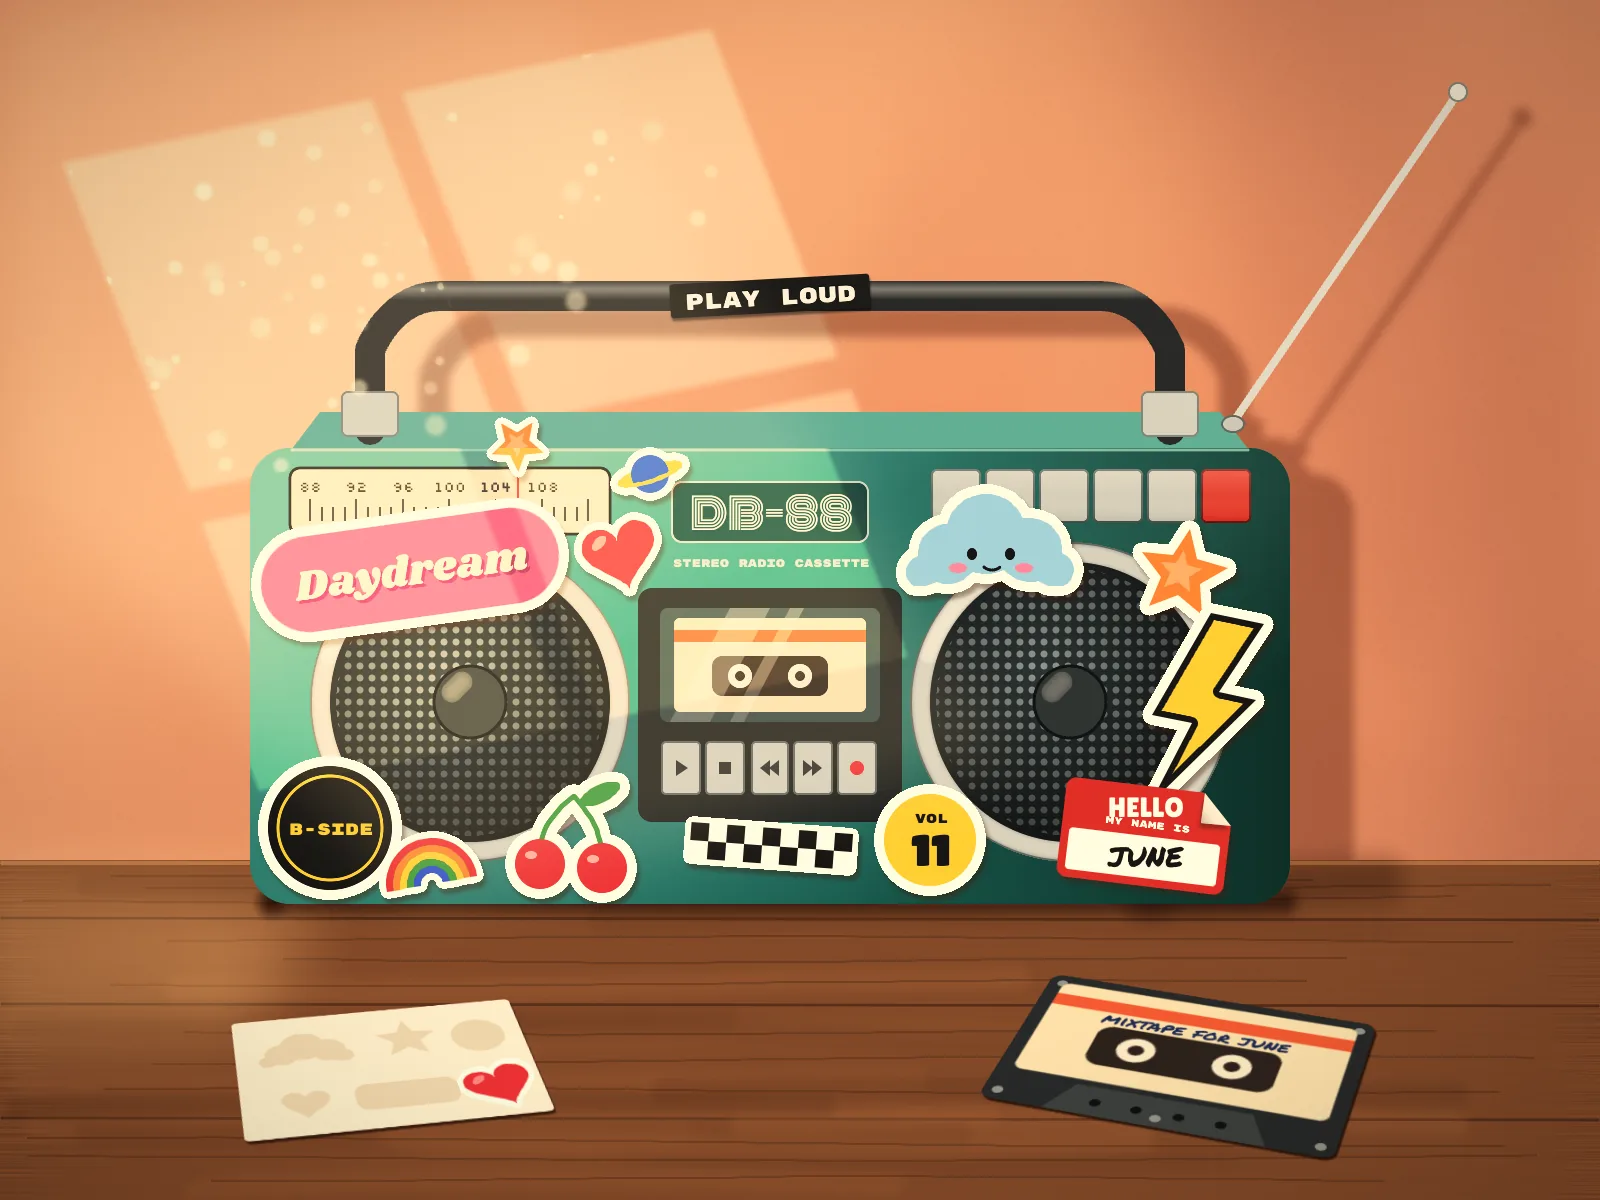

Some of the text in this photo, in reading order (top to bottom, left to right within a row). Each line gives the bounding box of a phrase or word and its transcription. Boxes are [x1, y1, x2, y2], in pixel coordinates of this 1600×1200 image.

[686, 285, 856, 310] PLAY LOUD
[300, 481, 558, 493] 88 92 96 100 104 108
[691, 494, 852, 532] DB-88
[295, 546, 529, 602] Daydream
[673, 558, 870, 569] STEREO RADIO CASSETTE
[914, 812, 948, 824] VOL
[1108, 796, 1184, 818] HELLO
[290, 822, 373, 836] B-SIDE
[1105, 815, 1190, 834] MY NAME IS
[911, 834, 950, 867] 11
[1106, 846, 1185, 868] JUNE
[1100, 1014, 1292, 1054] MIXTAPE FOR JUNE
